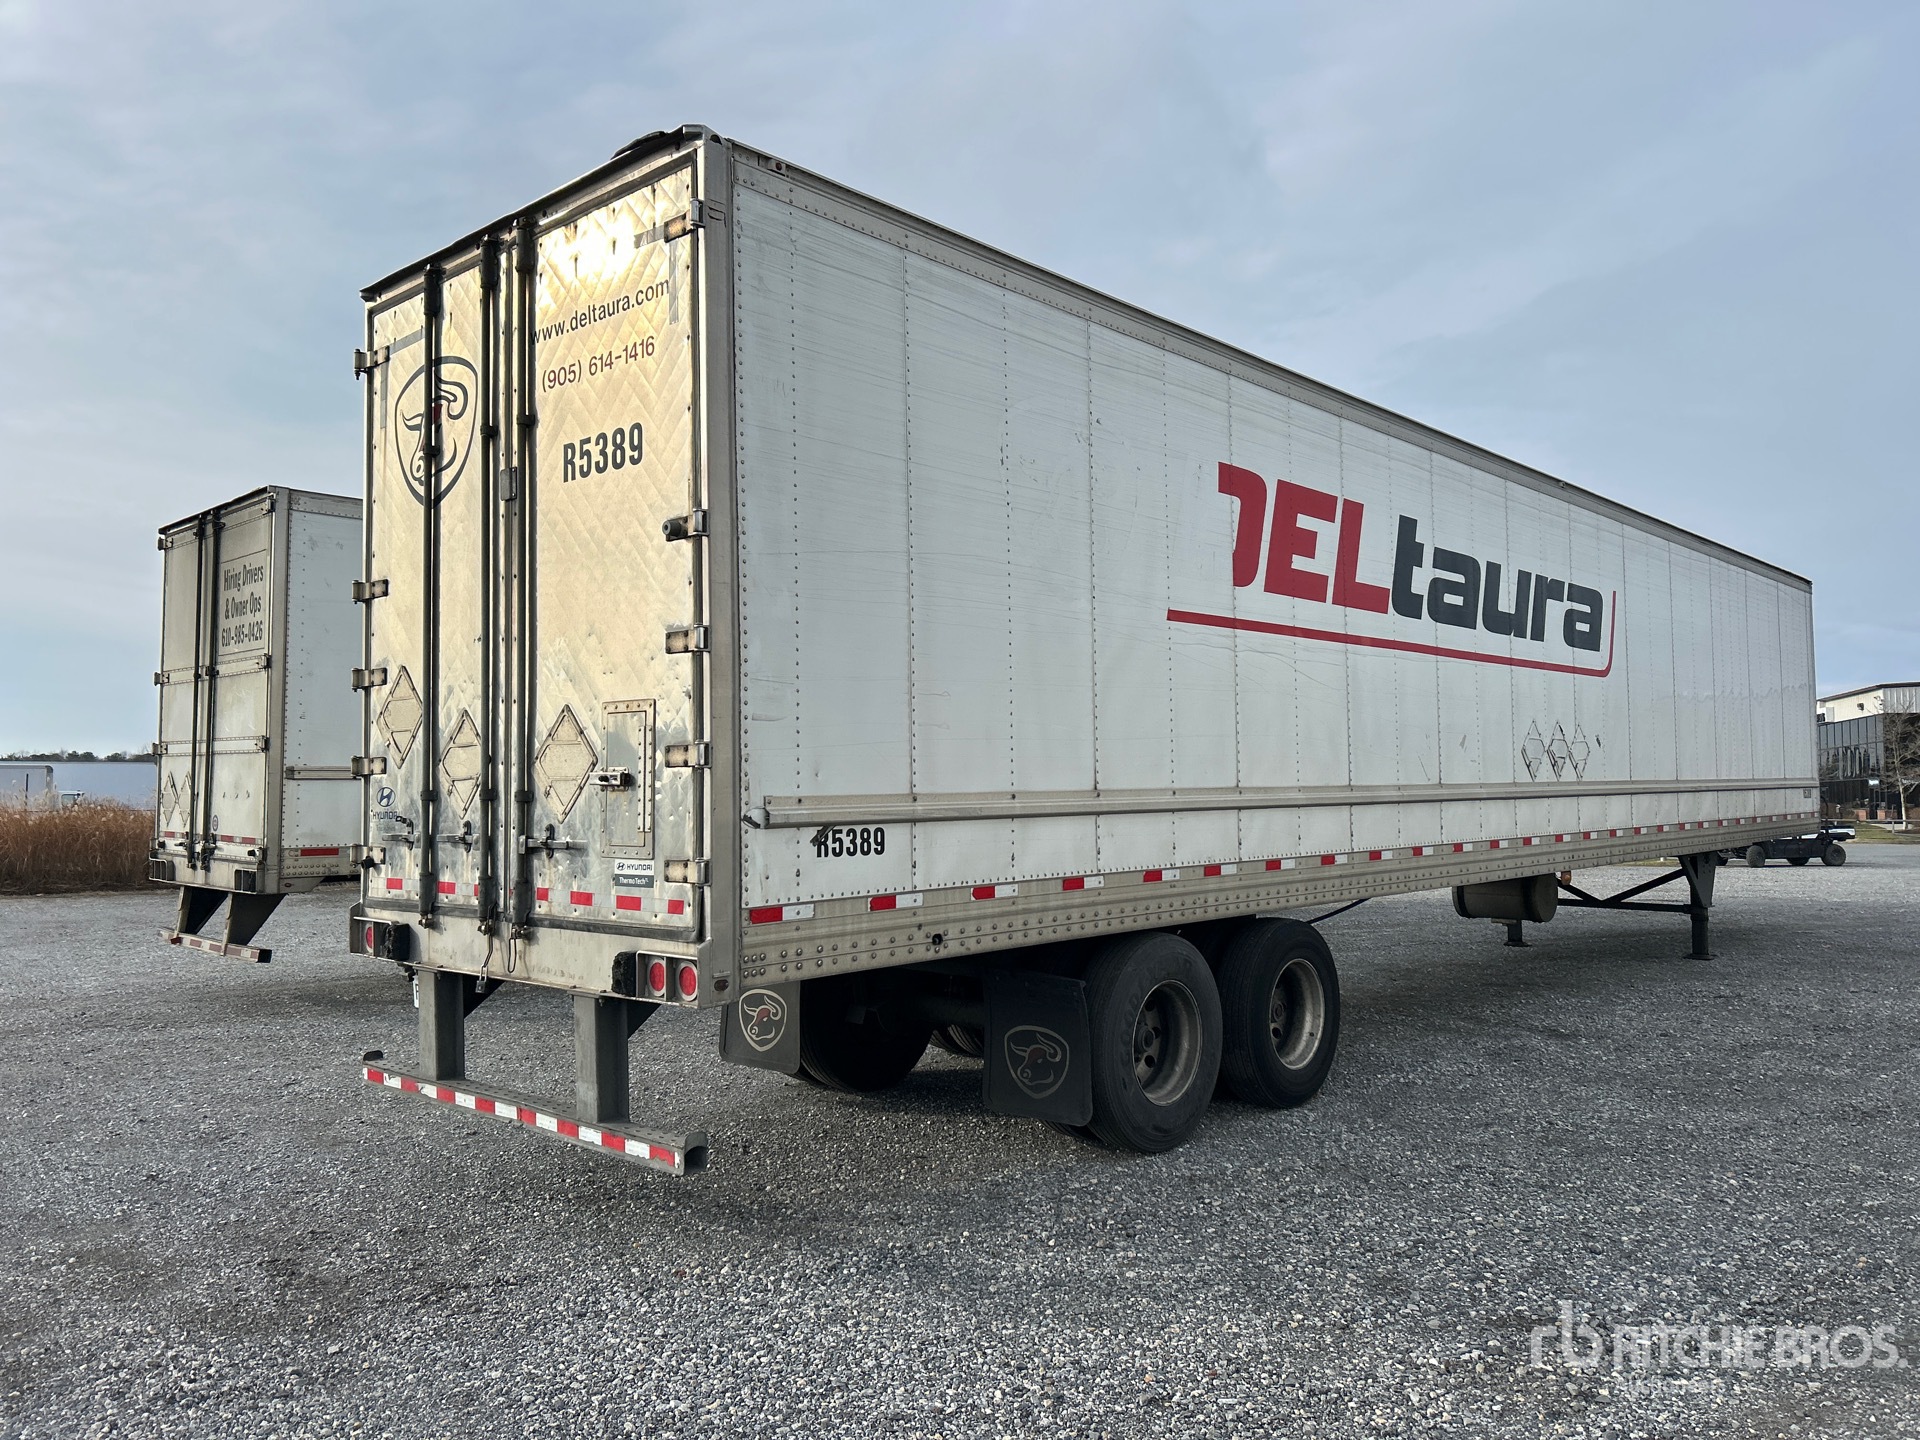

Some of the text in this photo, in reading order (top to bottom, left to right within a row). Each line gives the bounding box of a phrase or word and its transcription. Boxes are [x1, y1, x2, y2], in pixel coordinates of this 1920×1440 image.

[531, 279, 670, 346] www.deltaura.com
[542, 335, 656, 392] (905) 614-1416
[563, 422, 644, 483] R5389
[223, 562, 264, 592] Hiring Drivers
[225, 591, 262, 620] & Owner Ops
[221, 620, 263, 647] 610-985-0426
[372, 810, 399, 820] HYUNDA
[816, 827, 886, 858] R5389
[626, 863, 653, 871] HYUNDAI
